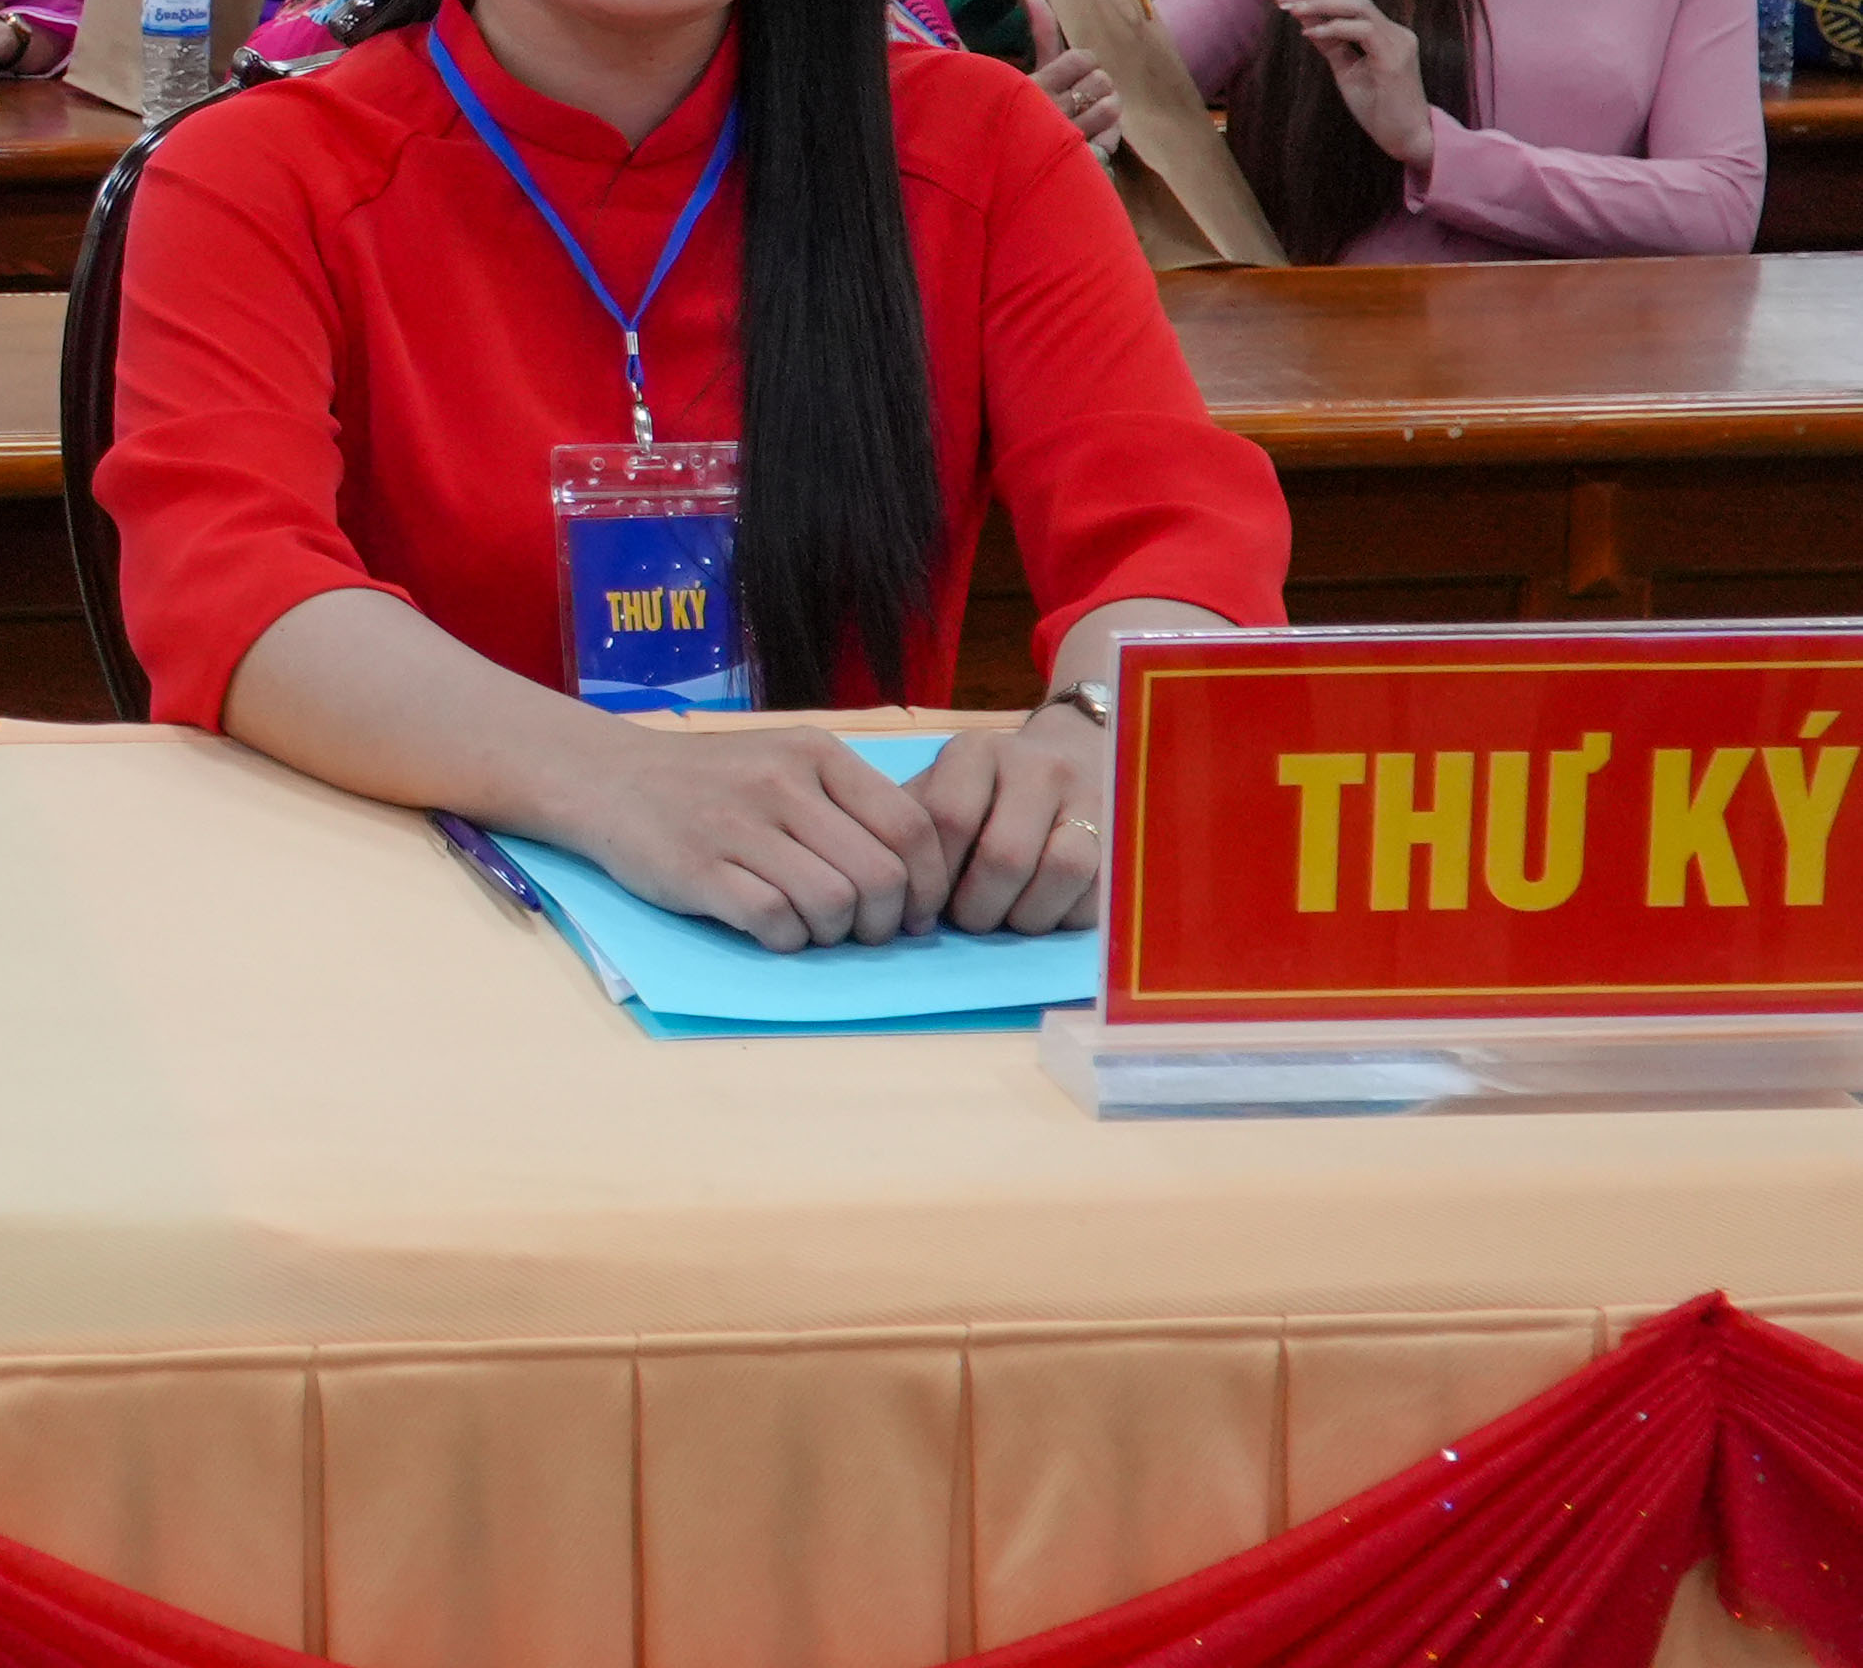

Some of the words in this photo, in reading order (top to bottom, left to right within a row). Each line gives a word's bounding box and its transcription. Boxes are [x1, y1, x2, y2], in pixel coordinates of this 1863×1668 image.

[606, 586, 664, 632] THƯ
[669, 579, 707, 631] KÝ
[1278, 732, 1612, 913] THƯ
[1646, 710, 1859, 907] KÝ
